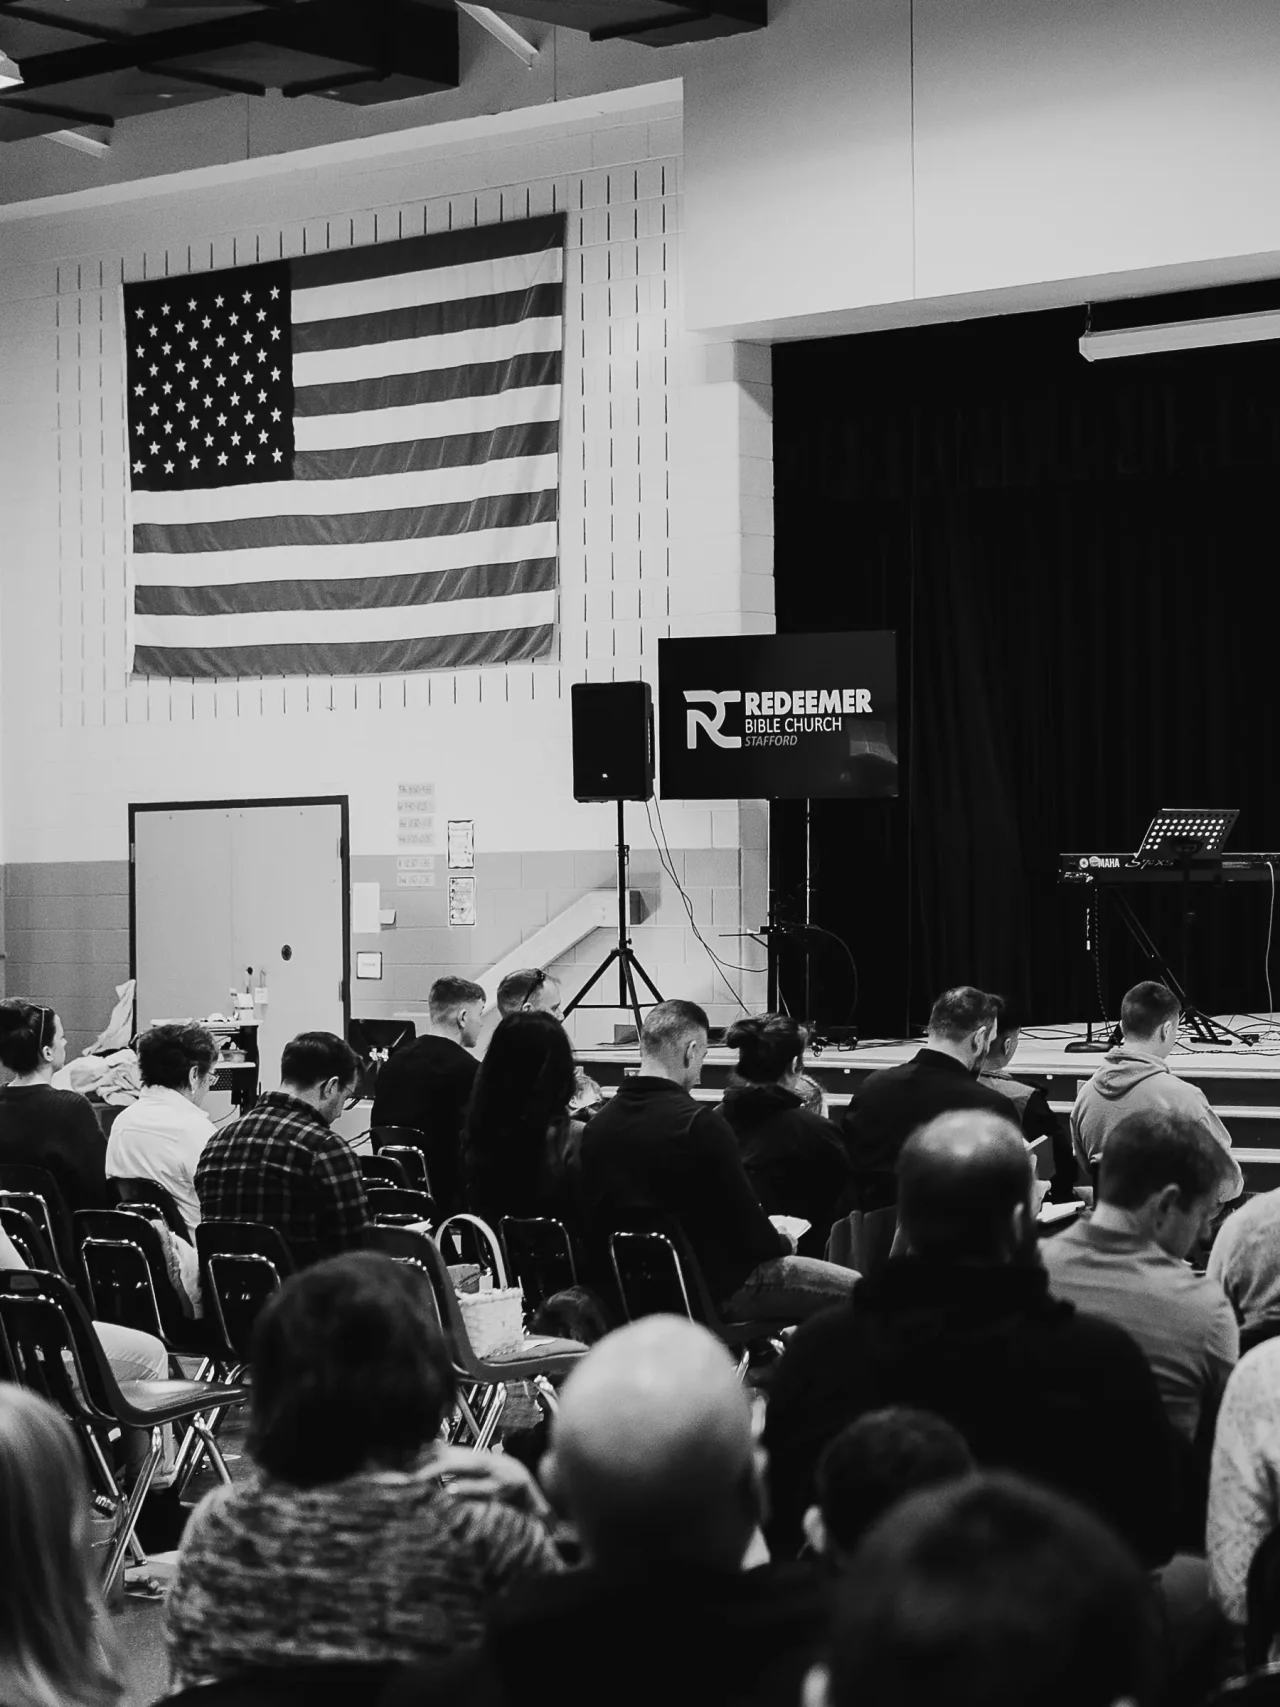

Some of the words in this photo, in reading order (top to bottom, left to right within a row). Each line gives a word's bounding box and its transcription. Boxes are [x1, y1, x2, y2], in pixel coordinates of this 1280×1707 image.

[744, 688, 873, 716] REDEEMER
[745, 718, 781, 734] BIBLE
[784, 716, 842, 733] CHURCH
[744, 735, 798, 747] STAFFORD
[1089, 856, 1120, 868] MAHA
